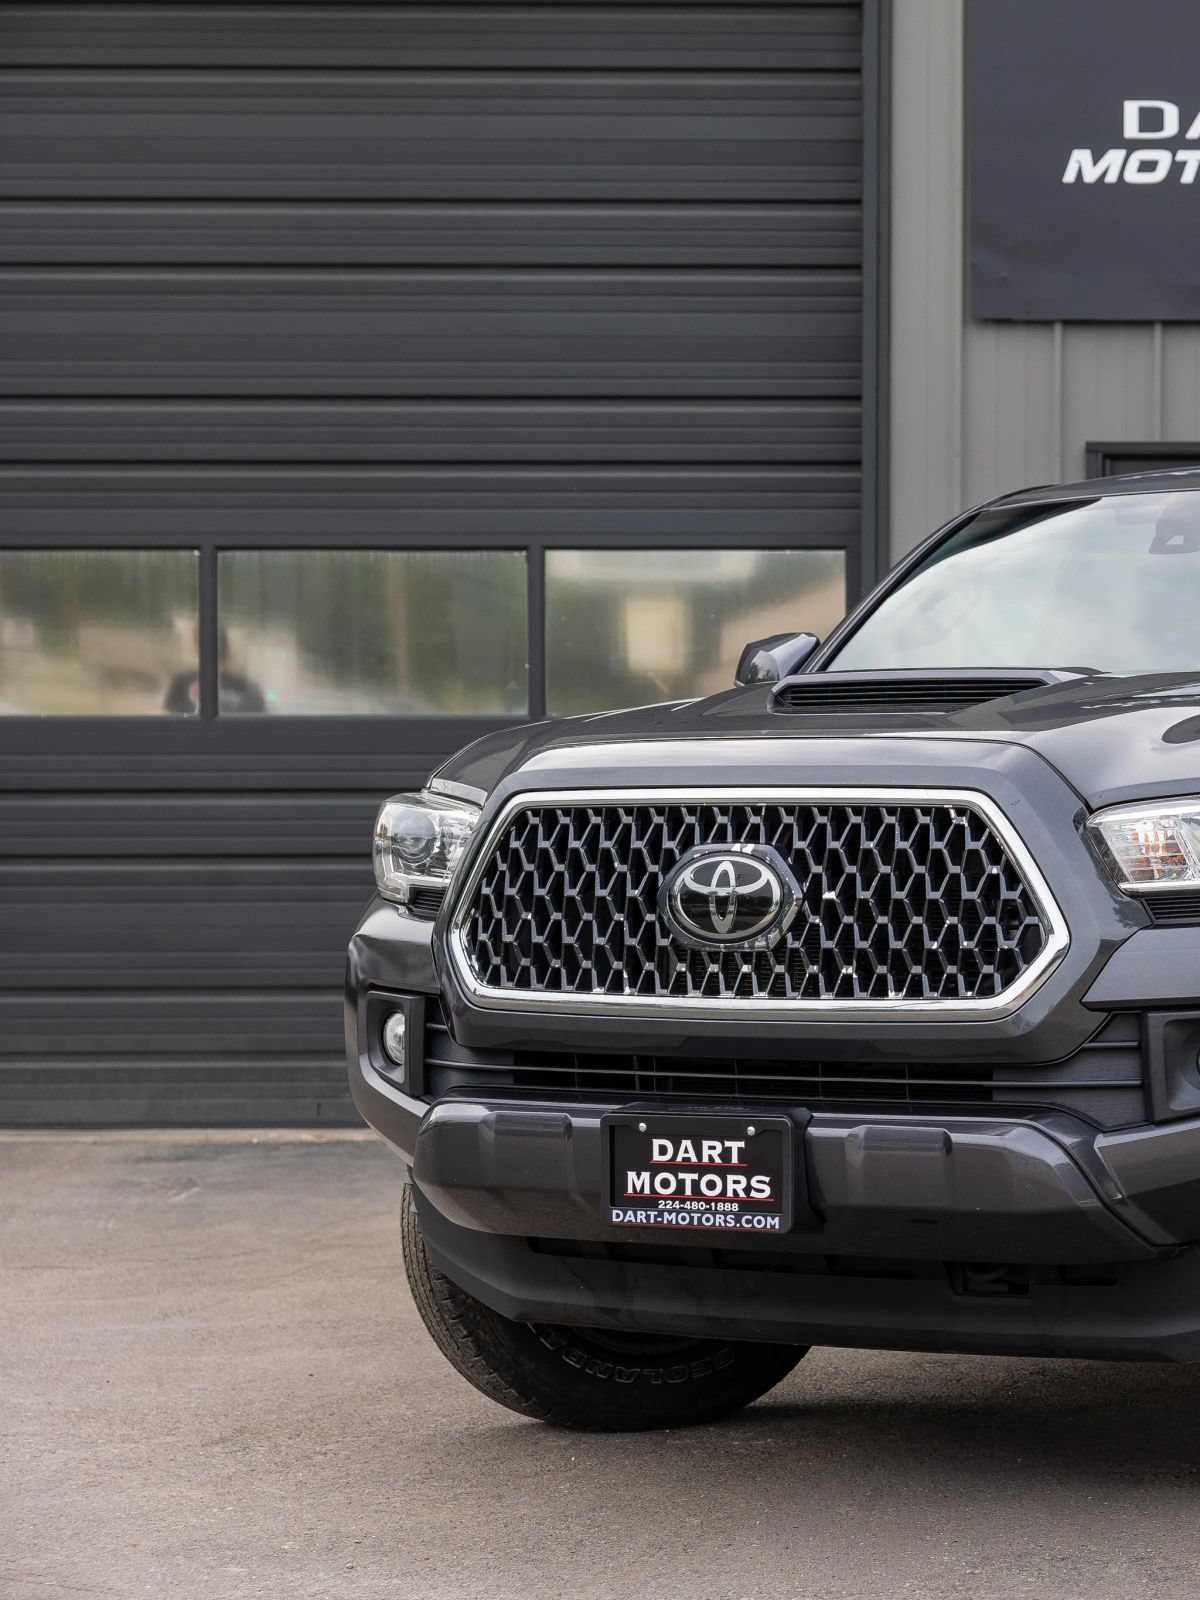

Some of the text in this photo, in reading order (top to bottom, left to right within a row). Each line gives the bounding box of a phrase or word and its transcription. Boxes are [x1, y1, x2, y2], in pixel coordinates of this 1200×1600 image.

[651, 1138, 745, 1164] DART
[626, 1171, 771, 1199] MOTORS
[657, 1200, 739, 1212] 224-480-1888
[611, 1209, 780, 1230] DART-MOTORS.COM
[526, 1321, 736, 1385] GEOLANDA
